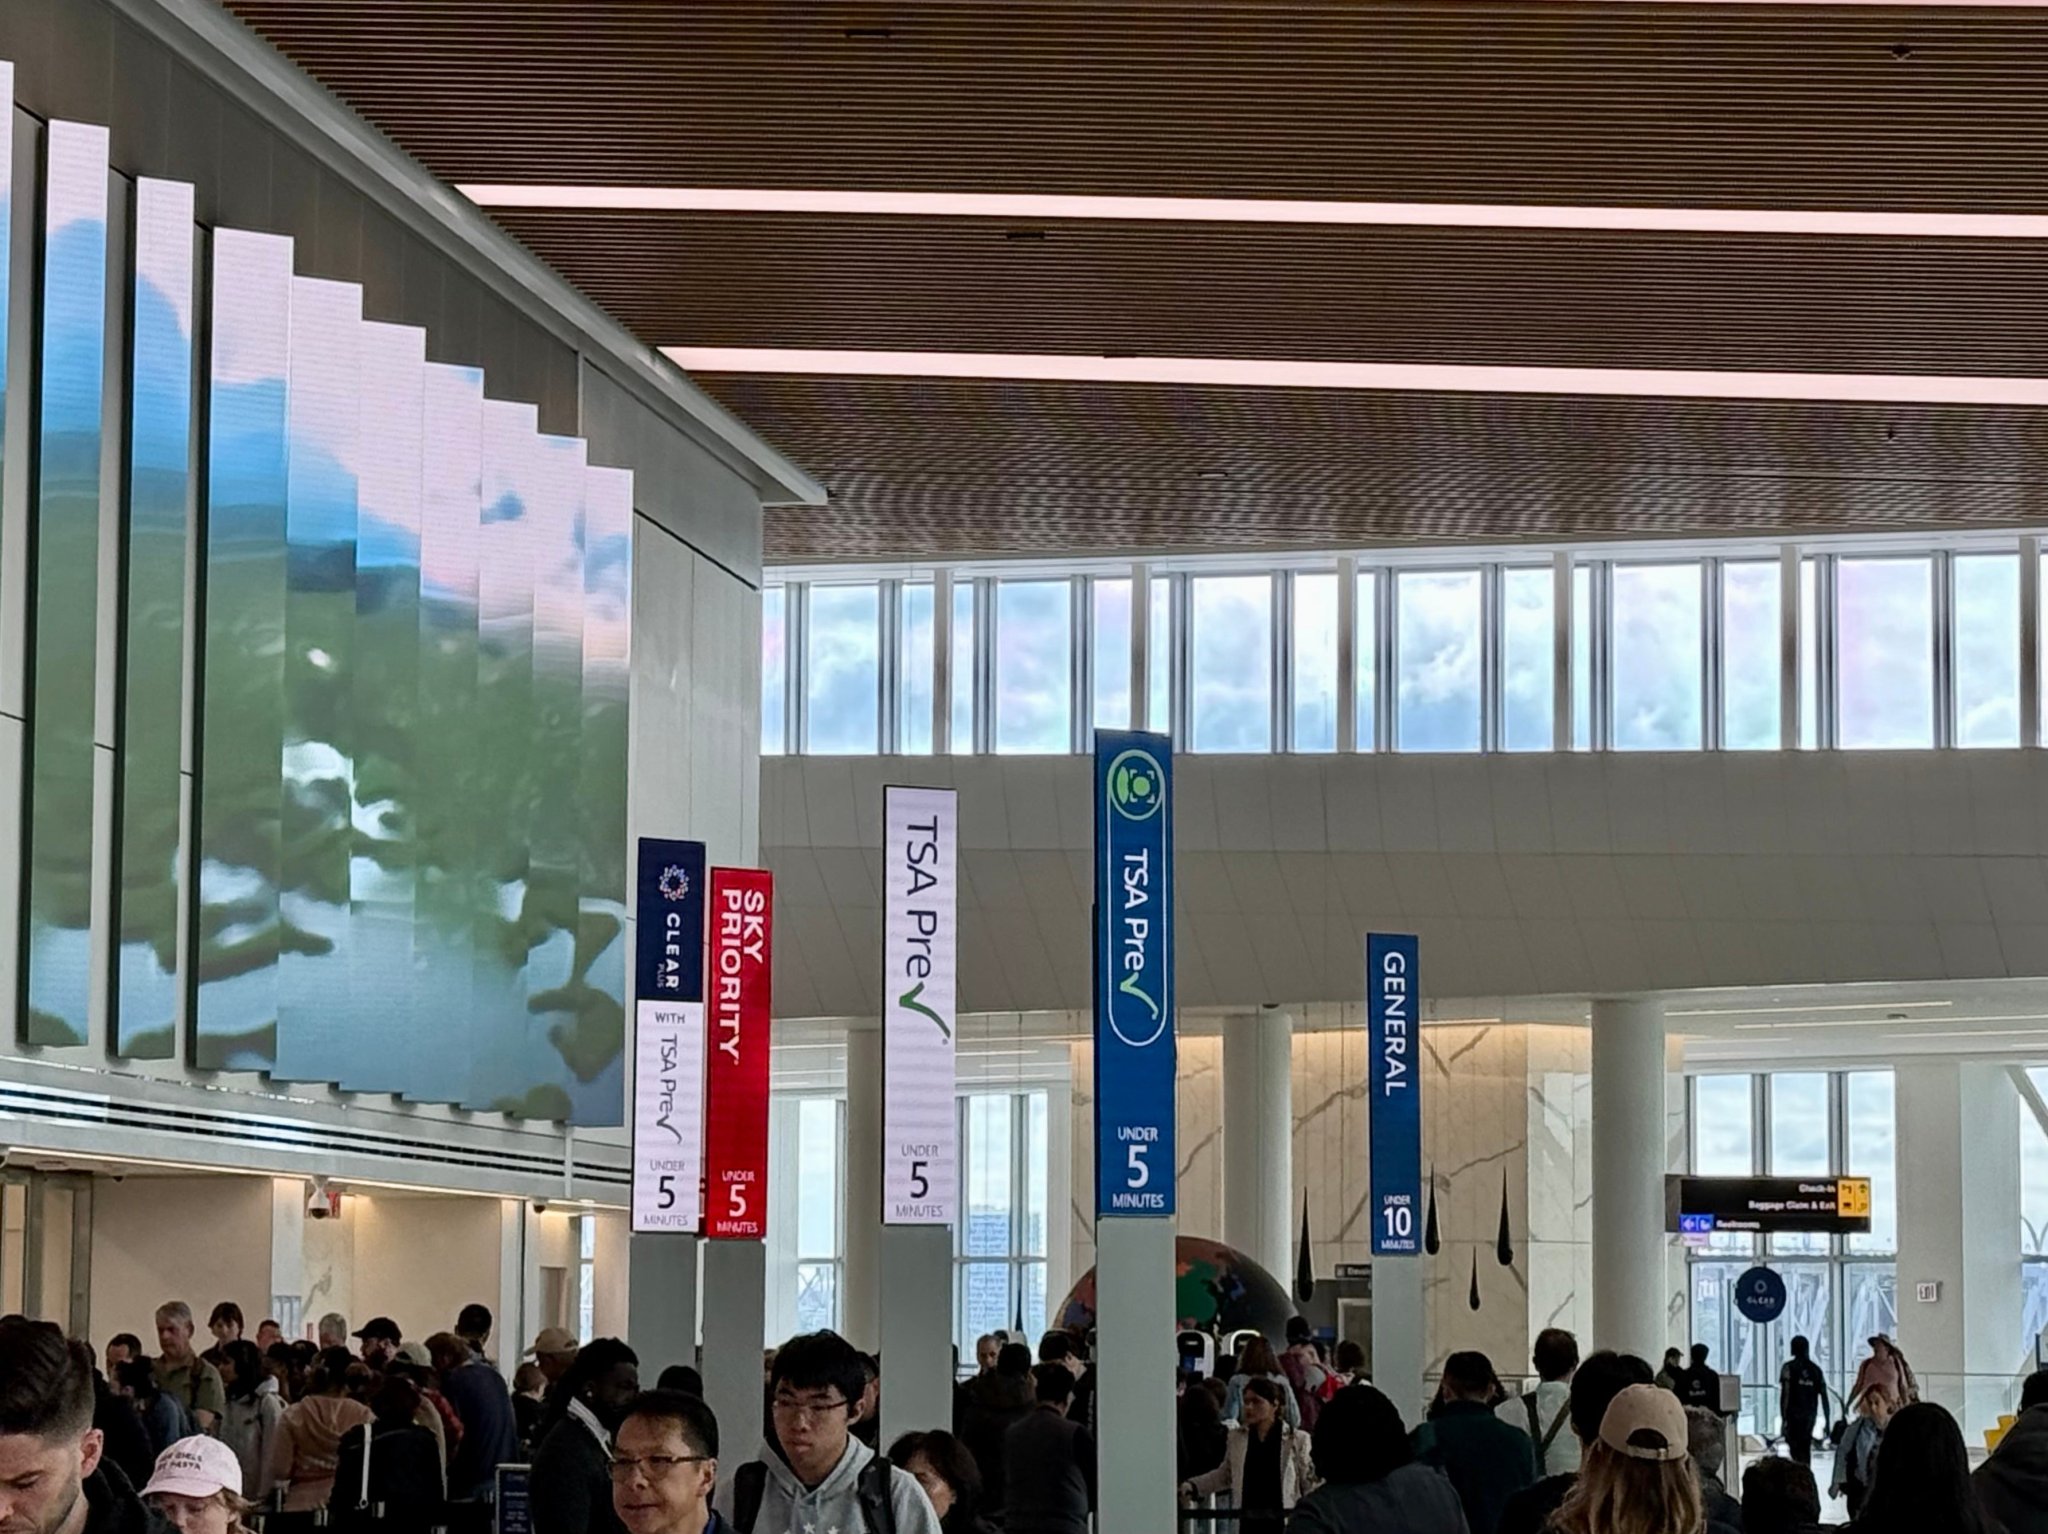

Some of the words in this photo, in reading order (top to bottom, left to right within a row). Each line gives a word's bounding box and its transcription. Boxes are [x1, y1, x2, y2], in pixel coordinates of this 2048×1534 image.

[906, 815, 938, 896] TSA
[1124, 848, 1149, 910] TSA
[744, 889, 765, 964] SKY
[666, 912, 681, 989] CLEAR
[656, 963, 665, 988] PLUS
[720, 889, 742, 1061] PRIORITY
[655, 1011, 686, 1024] WITH
[1384, 951, 1407, 1097] GENERAL
[661, 1033, 677, 1073] TSA
[1117, 1126, 1159, 1142] UNDER
[901, 1144, 939, 1157] UNDER
[649, 1159, 686, 1172] UNDER
[722, 1170, 755, 1182] UNDER
[910, 1160, 929, 1199] 5
[1127, 1145, 1149, 1188] 5
[657, 1175, 675, 1209] 5
[729, 1184, 747, 1217] 5
[1112, 1193, 1165, 1208] MINUTES
[1383, 1194, 1411, 1205] UNDER
[643, 1214, 689, 1227] MINUTES
[896, 1204, 944, 1218] MINUTES
[1383, 1206, 1412, 1237] 10
[716, 1221, 759, 1234] MINUTES
[1381, 1239, 1416, 1250] MINUTES
